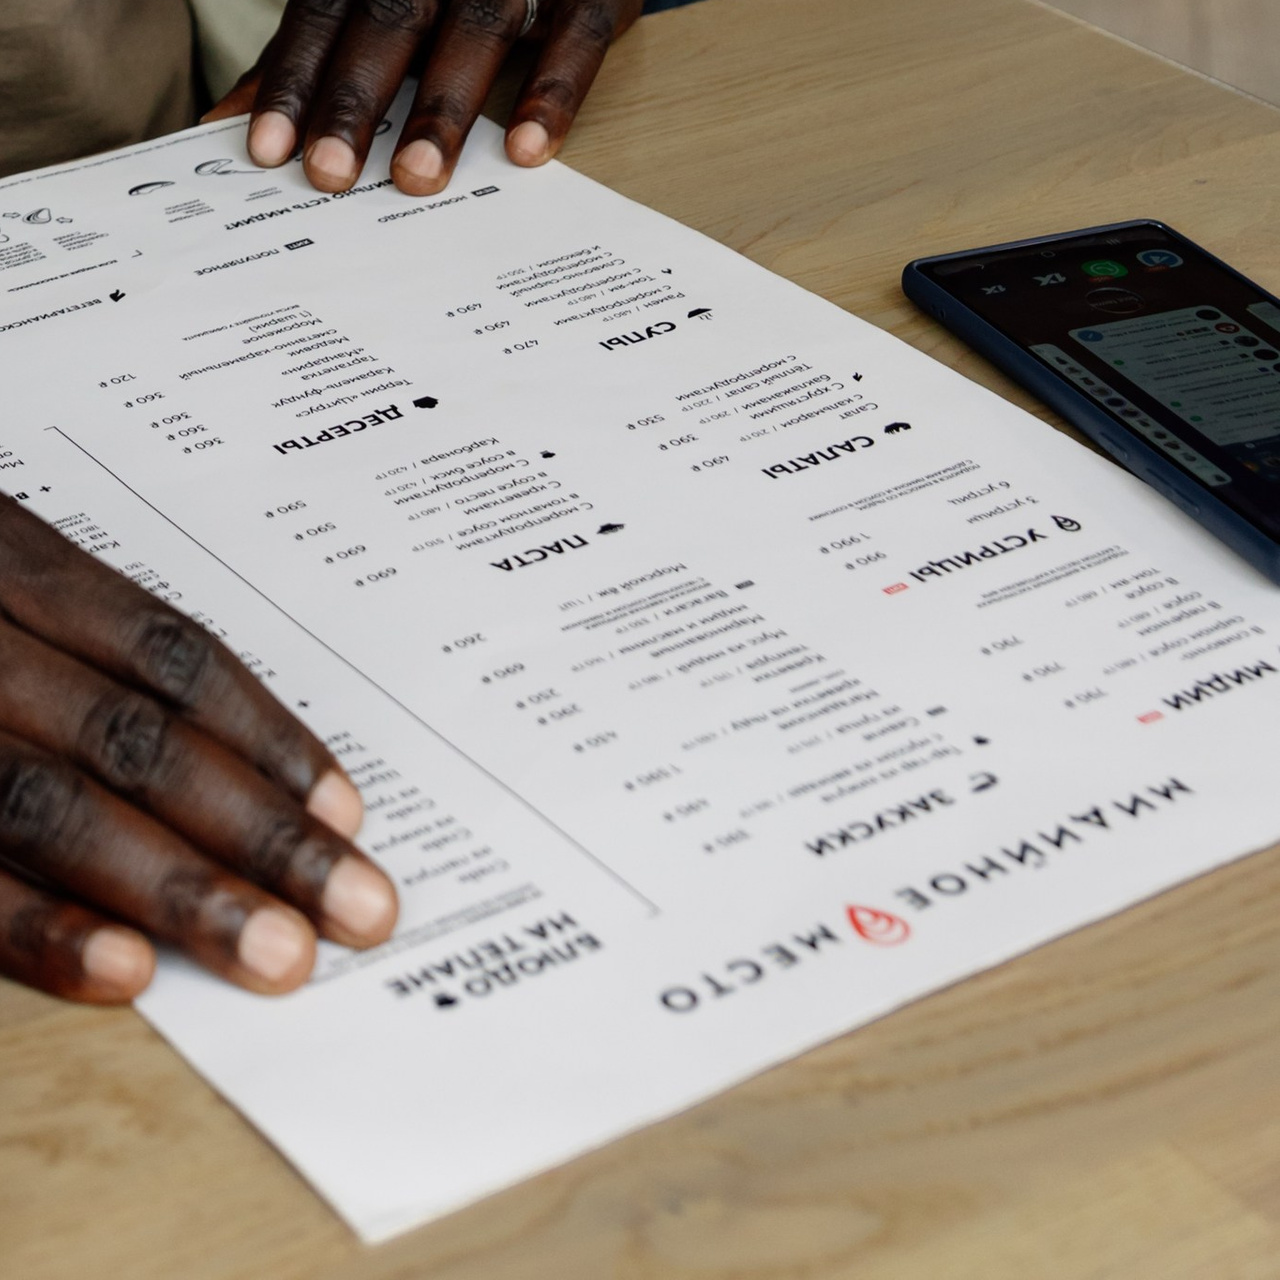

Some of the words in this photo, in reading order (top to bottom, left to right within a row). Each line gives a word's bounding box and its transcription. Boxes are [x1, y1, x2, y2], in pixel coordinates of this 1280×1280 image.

[424, 194, 467, 210] НОВОЕ
[376, 206, 425, 223] БЛЮДО
[192, 248, 279, 276] ПОПУЛЯРНОЕ
[495, 254, 603, 290] морепродуктами
[508, 258, 625, 297] Сливочно-сырный
[523, 271, 632, 307] морепродуктами
[607, 275, 656, 292] Том-ям
[577, 293, 596, 301] 480
[642, 291, 685, 308] Рамен
[298, 309, 312, 318] (1
[455, 302, 481, 313] 490
[552, 287, 662, 325] морепродуктами
[612, 309, 631, 318] 480
[241, 317, 322, 344] Мороженое
[247, 313, 297, 333] шарик)
[483, 320, 509, 331] 490
[512, 339, 538, 350] 470
[597, 321, 676, 351] СУПЫ
[177, 328, 337, 380] сметанно-карамельный
[286, 335, 350, 357] Медовик
[280, 347, 364, 375] «Мандарин»
[299, 354, 378, 380] Тарталетка
[109, 373, 136, 384] 120
[674, 358, 787, 401] морепродуктами
[759, 362, 812, 385] Тёплый
[270, 366, 394, 408] Карамель-фундук
[359, 378, 413, 396] Террин
[723, 381, 759, 398] салат
[740, 373, 830, 410] баклажанами
[830, 382, 844, 390] С
[135, 391, 165, 404] 360
[294, 394, 358, 417] «Цитрус»
[691, 398, 712, 407] 220
[748, 386, 831, 419] хрустящими
[161, 411, 191, 424] 360
[636, 413, 665, 426] 530
[709, 410, 730, 420] 290
[779, 397, 853, 427] кальмаром
[838, 402, 878, 420] Салат
[177, 423, 208, 437] 360
[271, 403, 404, 455] ДЕСЕРТЫ
[750, 428, 769, 437] 210
[193, 436, 224, 449] 360
[668, 433, 698, 446] 390
[419, 436, 499, 464] Карбонара
[759, 435, 874, 479] САЛАТЫ
[464, 453, 504, 469] соусе
[515, 458, 529, 466] С
[701, 455, 729, 467] 490
[386, 466, 407, 475] 420
[428, 466, 465, 480] биск
[392, 462, 515, 505] морепродуктами
[395, 481, 416, 491] 420
[496, 475, 535, 491] соусе
[546, 480, 561, 488] С
[997, 480, 1010, 489] 6
[453, 488, 495, 504] песто
[462, 484, 547, 515] креветками
[946, 483, 998, 505] устриц
[1024, 495, 1038, 504] 3
[275, 499, 306, 514] 590
[419, 506, 440, 516] 480
[497, 497, 568, 523] томатном
[578, 502, 593, 510] С
[965, 498, 1025, 524] устрицы
[305, 521, 336, 536] 590
[454, 505, 579, 550] морепродуктами
[456, 520, 497, 537] соусе
[423, 538, 444, 547] 510
[335, 544, 366, 559] 690
[487, 533, 589, 572] ПАСТА
[906, 527, 1048, 583] УСТРИЦЫ
[365, 566, 396, 582] 690
[1160, 660, 1275, 711] МИДИИ
[803, 788, 955, 858] ЗАКУСКИ
[893, 776, 1194, 911] МИДИЙНОЕ
[657, 923, 840, 1014] МЕСТО
